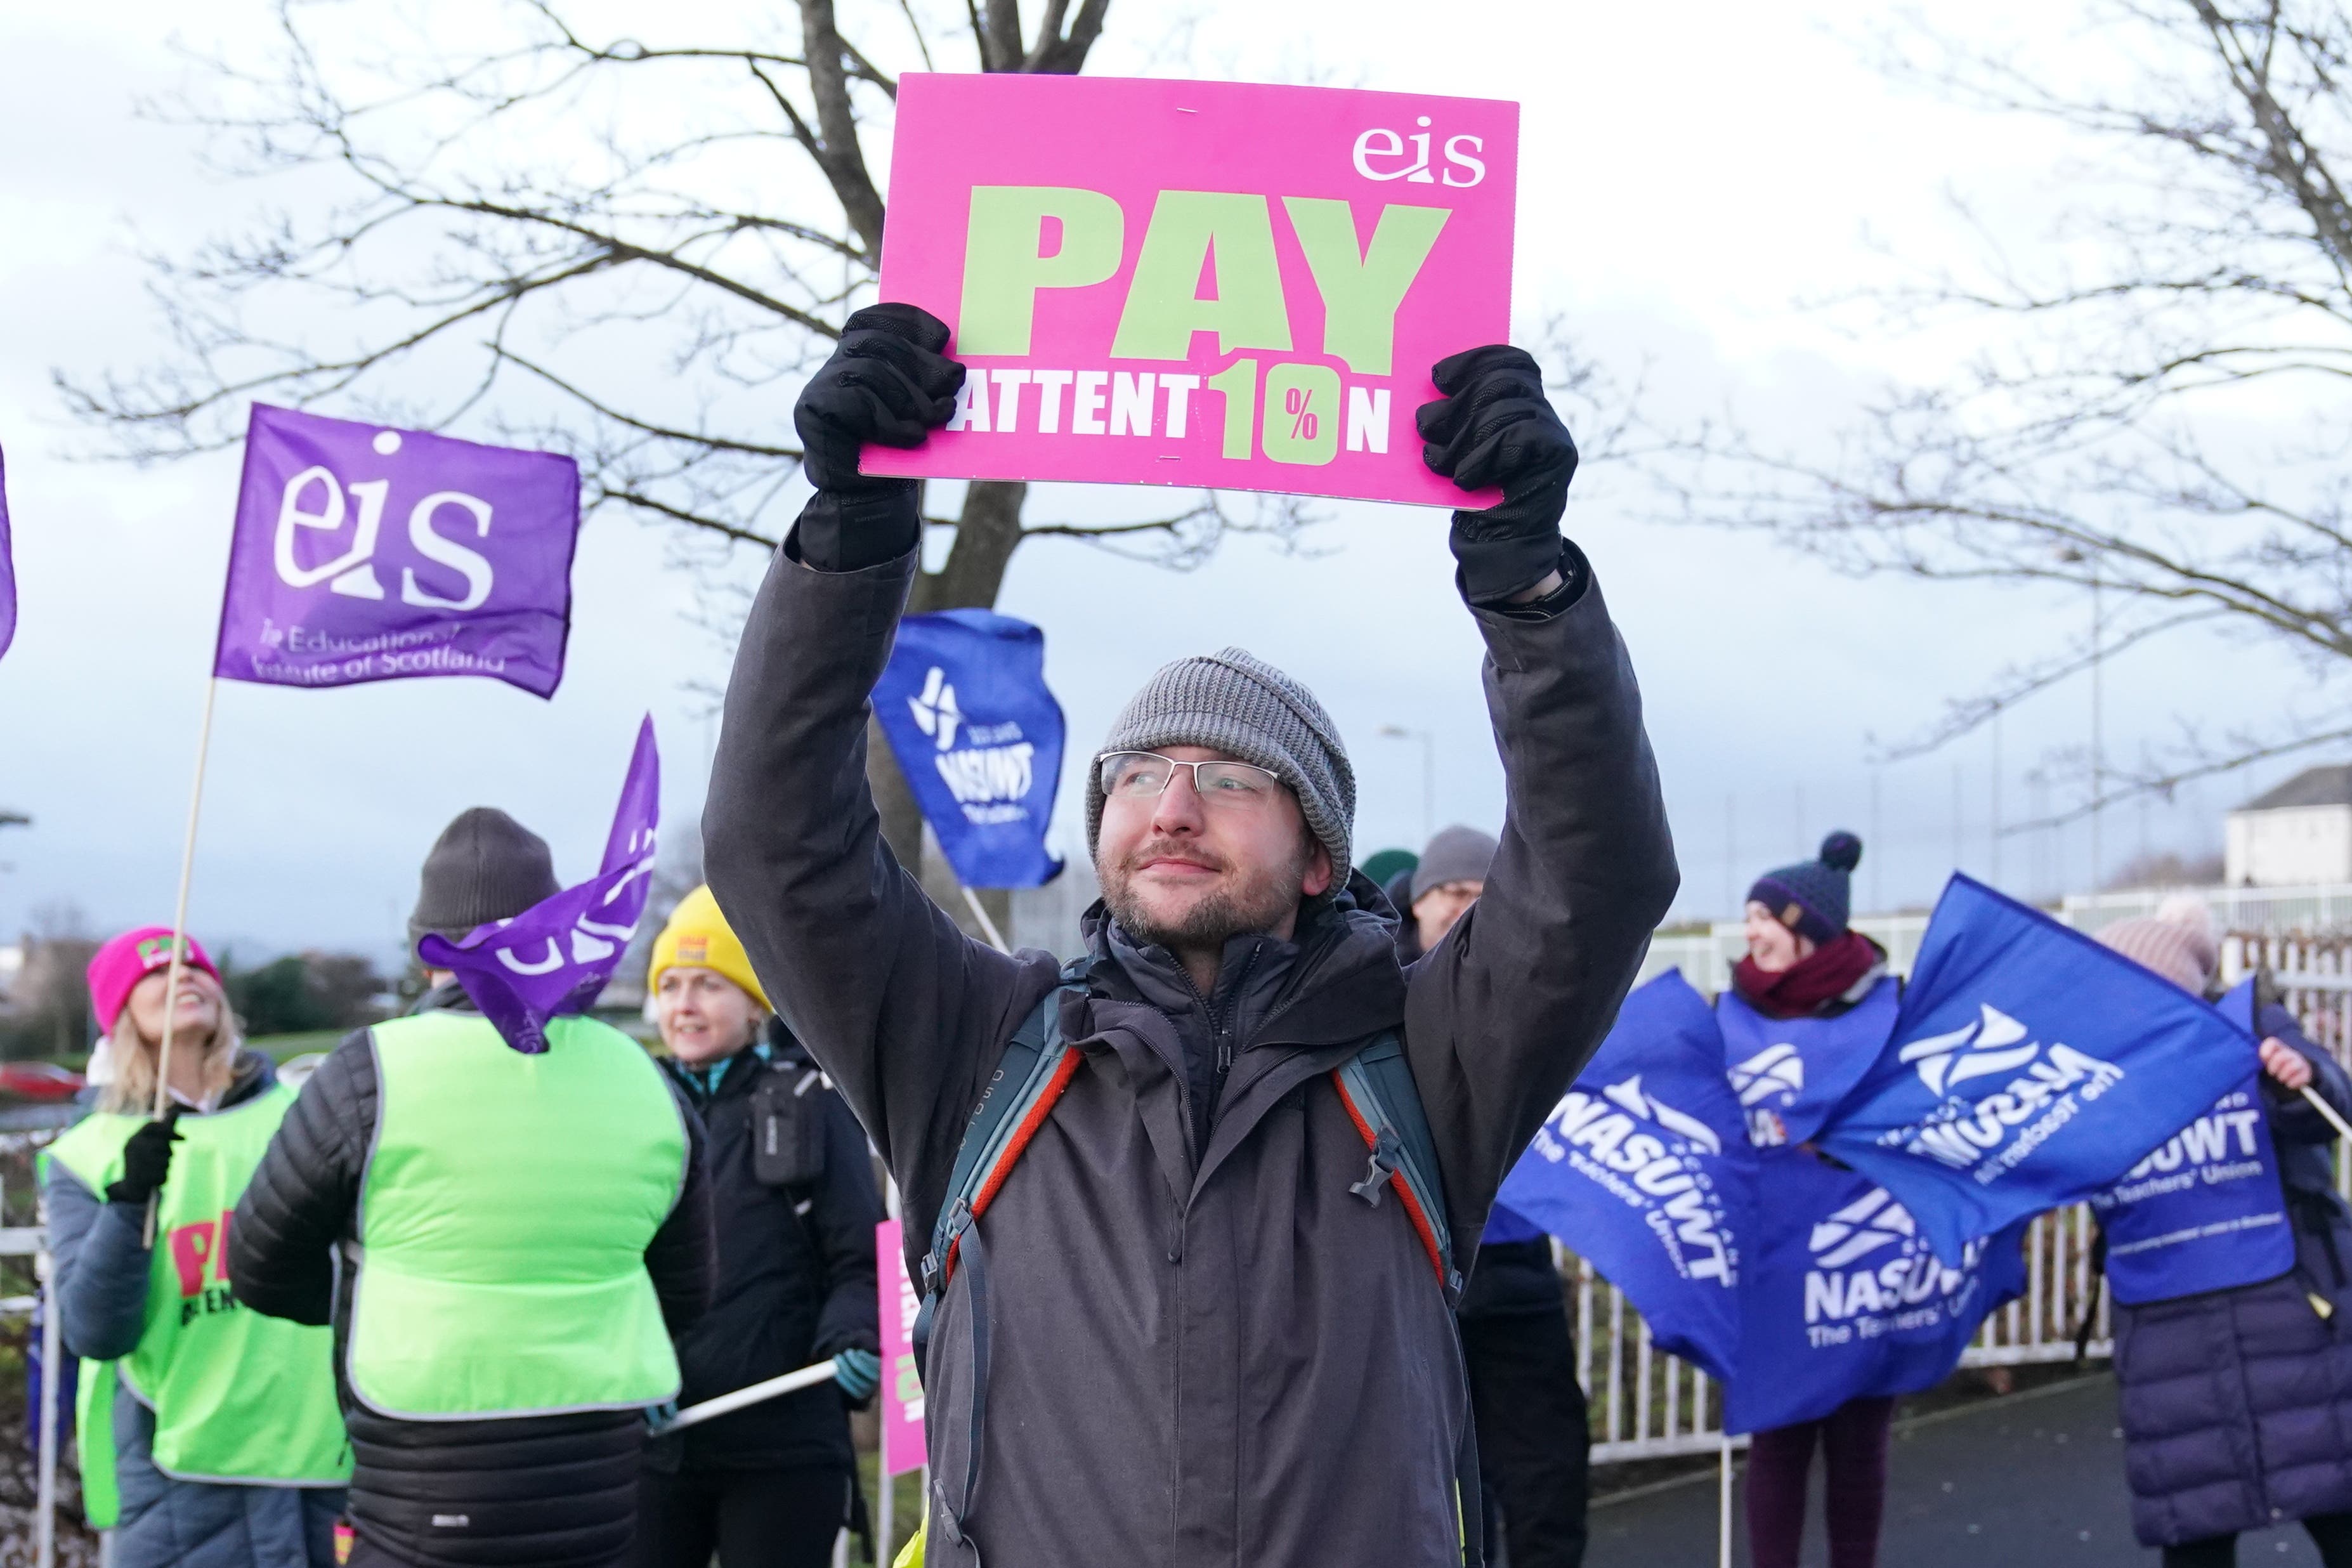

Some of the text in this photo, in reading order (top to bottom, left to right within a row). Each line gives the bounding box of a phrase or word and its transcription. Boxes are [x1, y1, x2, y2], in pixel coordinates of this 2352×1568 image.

[1350, 115, 1487, 188] eis
[956, 184, 1454, 377] PAY
[273, 430, 494, 611] eis
[1546, 1092, 1731, 1288] NASUWT
